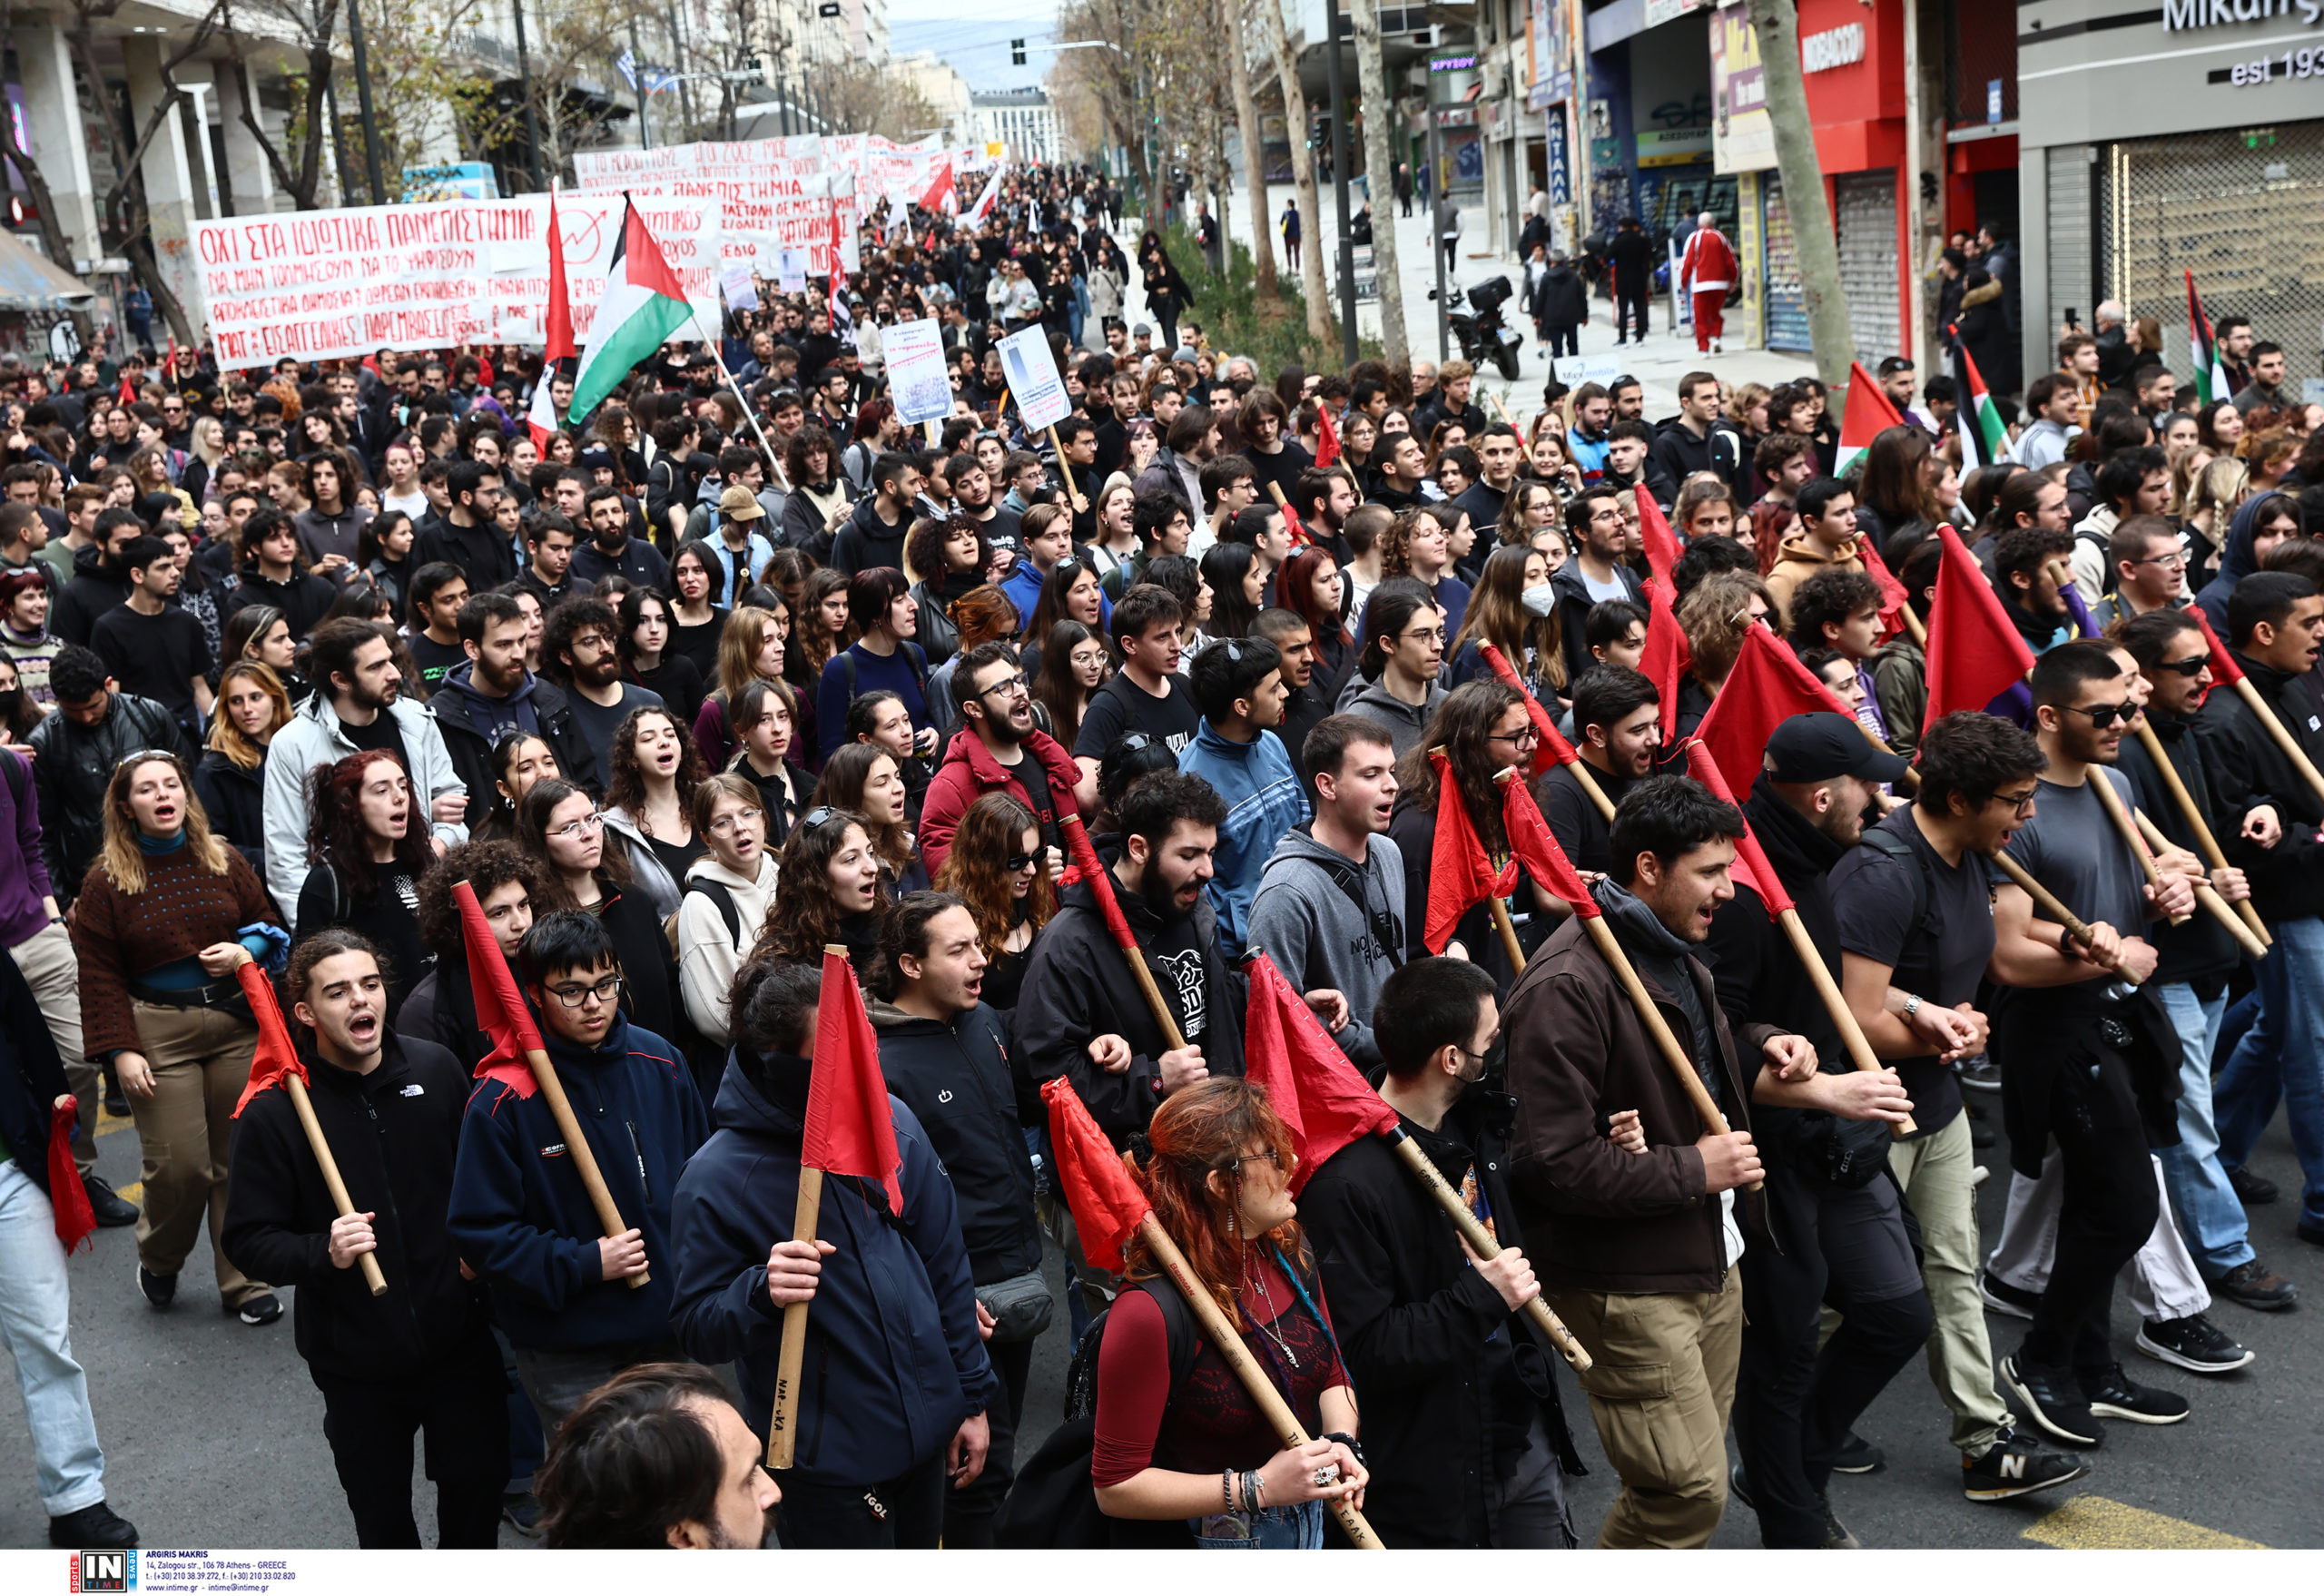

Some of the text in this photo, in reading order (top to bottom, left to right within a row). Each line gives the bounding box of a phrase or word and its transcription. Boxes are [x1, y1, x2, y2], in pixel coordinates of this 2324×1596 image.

[2230, 54, 2271, 86] est
[200, 208, 537, 265] ΟΧΙ ΣΤΑ ΙΔΙΩΤΙΚΑ ΠΑΝΕΠΙΣΤΗΜΙΑ
[208, 271, 231, 297] ΝΑ
[234, 265, 266, 292] ΜΗΝ
[385, 254, 399, 274] ΤΟ
[1999, 1453, 2027, 1480] N
[863, 1493, 888, 1519] IGOL
